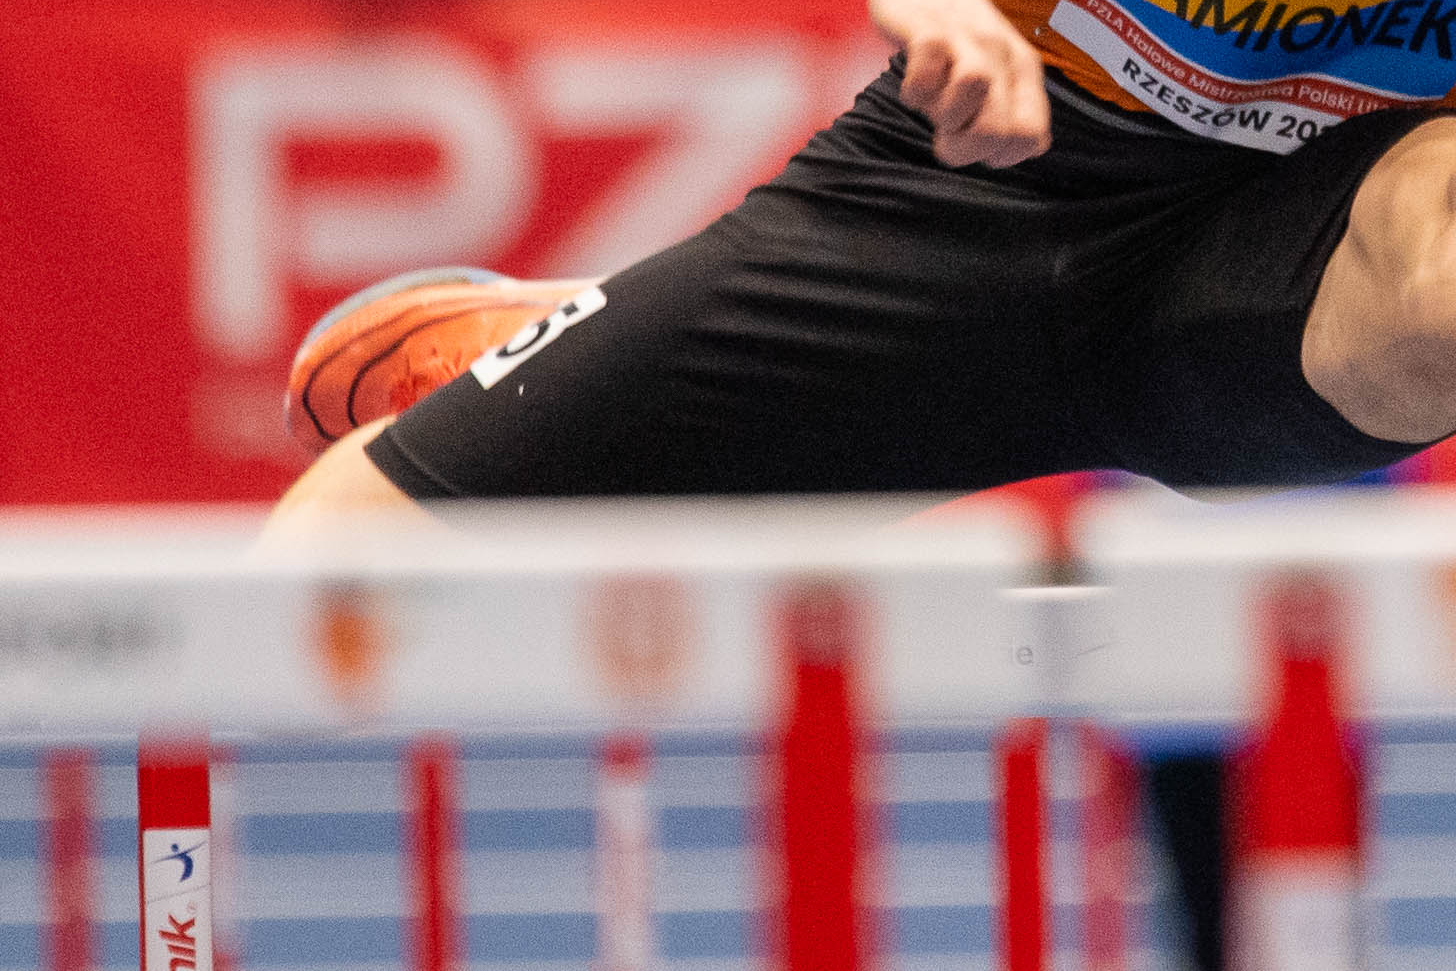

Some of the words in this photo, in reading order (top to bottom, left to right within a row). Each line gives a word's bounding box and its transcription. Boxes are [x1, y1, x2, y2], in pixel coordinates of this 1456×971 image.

[1121, 57, 1273, 132] RZESZÓW
[1275, 115, 1334, 142] 20
[1126, 28, 1186, 80] Halowe
[1298, 84, 1354, 111] Polski
[196, 39, 880, 357] PZ
